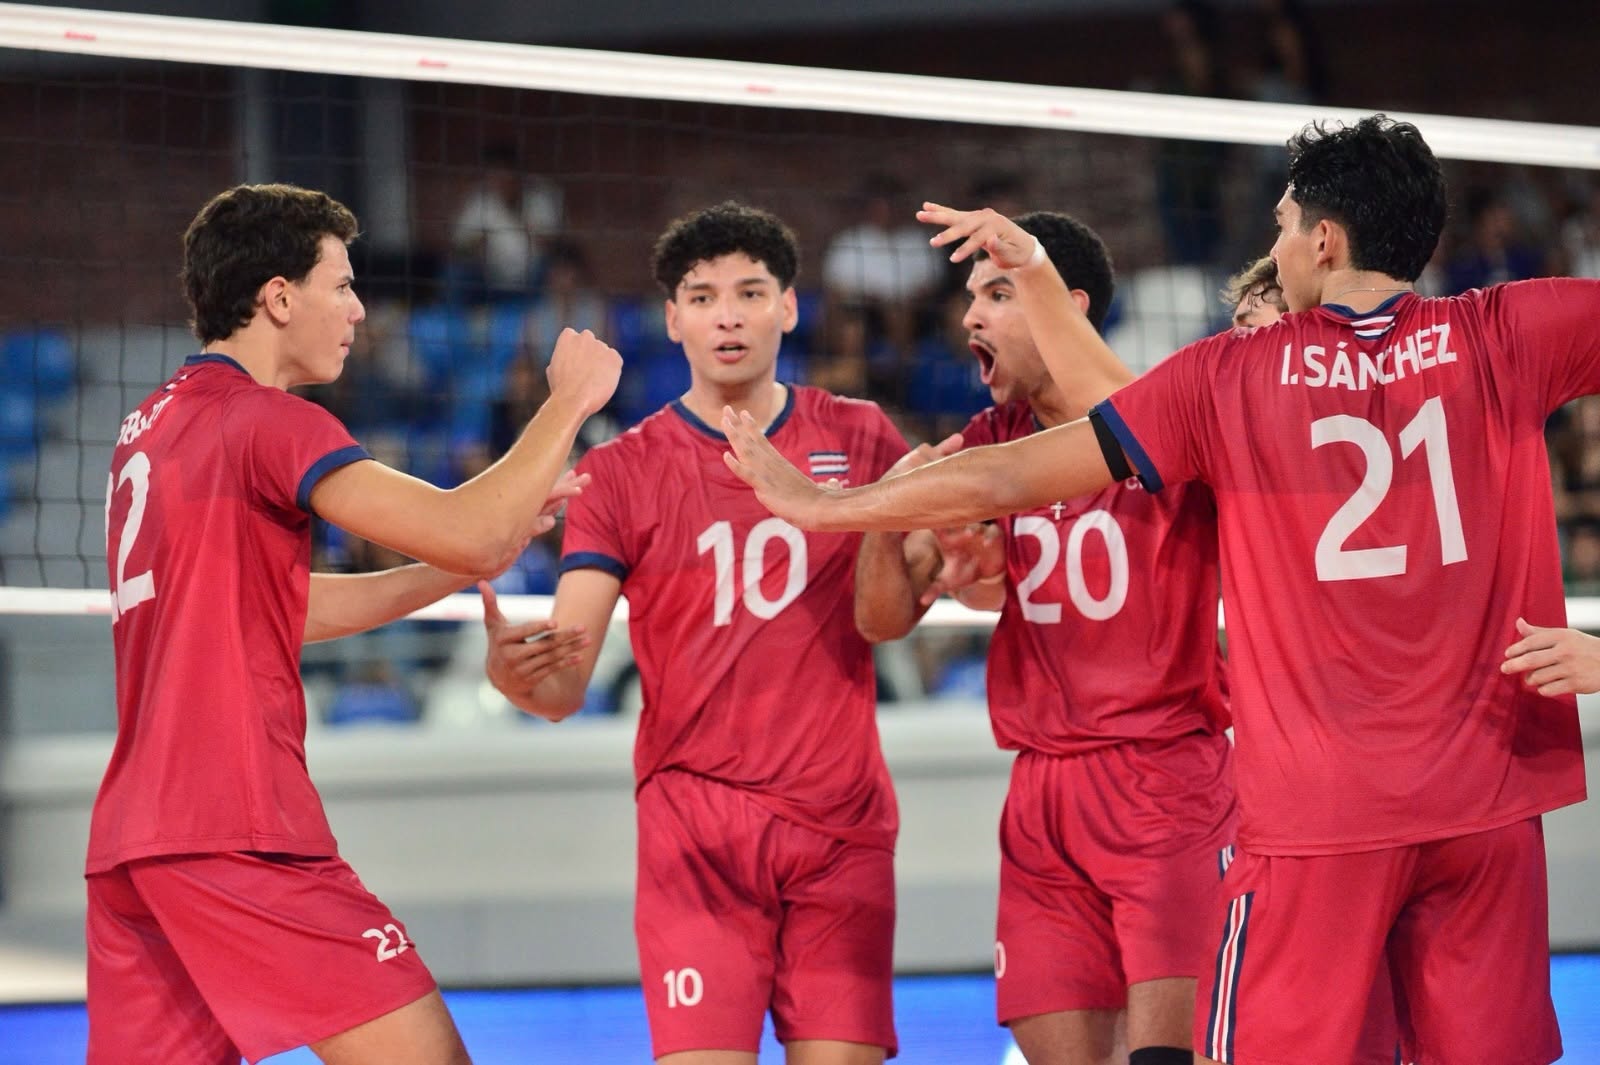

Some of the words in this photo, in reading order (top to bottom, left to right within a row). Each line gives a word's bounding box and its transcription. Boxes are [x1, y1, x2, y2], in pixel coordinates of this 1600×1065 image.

[1310, 395, 1468, 582] 21
[697, 517, 808, 627] 10
[1014, 509, 1129, 624] 20
[361, 923, 409, 963] 22
[994, 940, 1007, 979] 0
[663, 967, 704, 1008] 10
